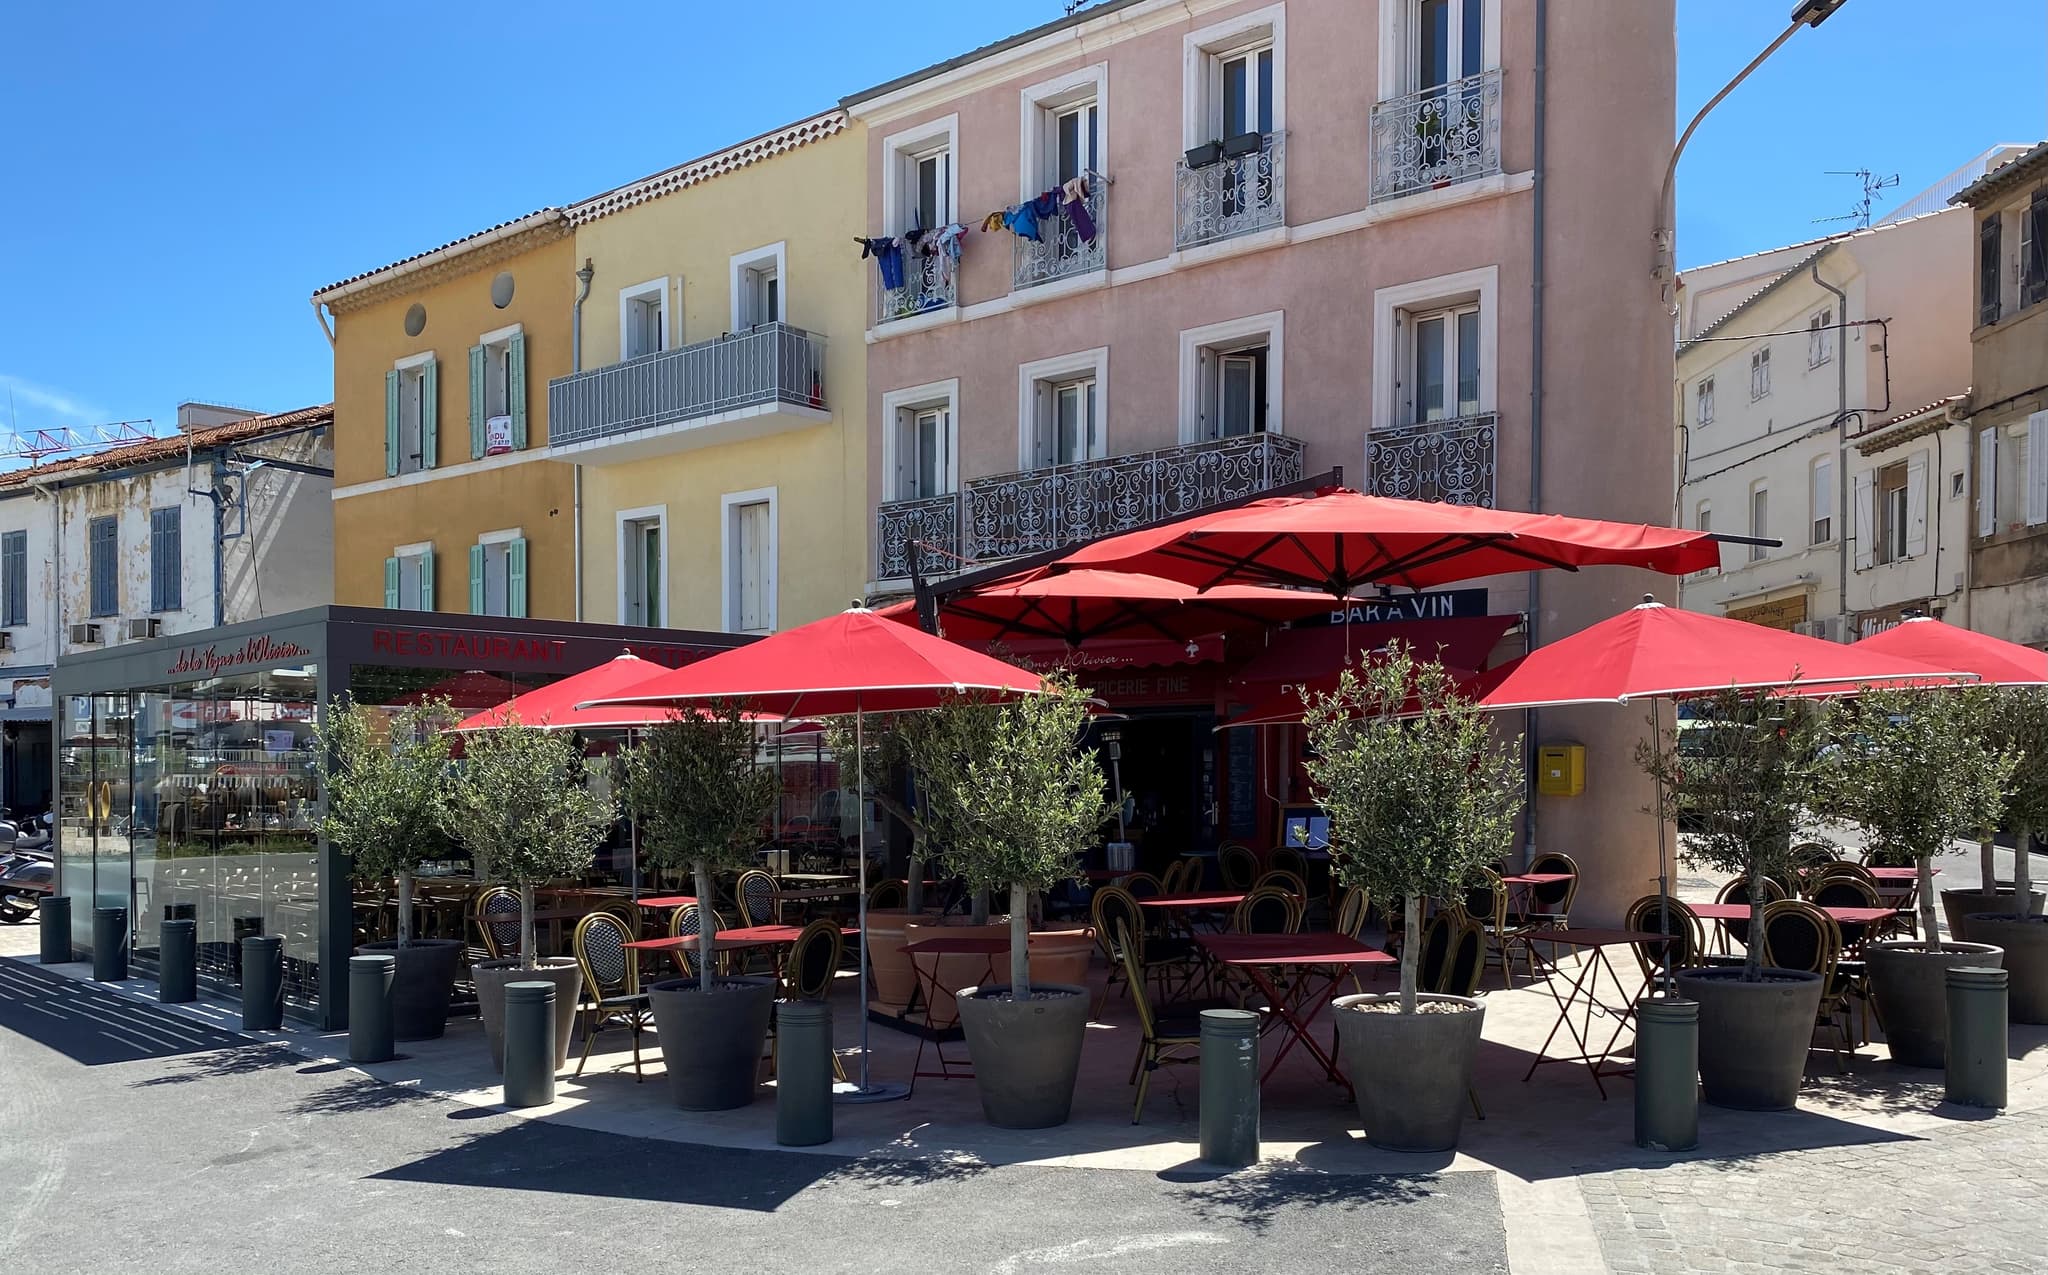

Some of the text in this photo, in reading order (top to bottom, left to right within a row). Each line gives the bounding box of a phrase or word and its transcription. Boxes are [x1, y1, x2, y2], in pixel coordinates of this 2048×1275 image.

[1411, 595, 1453, 618] VIN
[372, 629, 567, 663] RESTAURANT
[203, 645, 233, 676] Vigne
[1157, 675, 1189, 693] FINE
